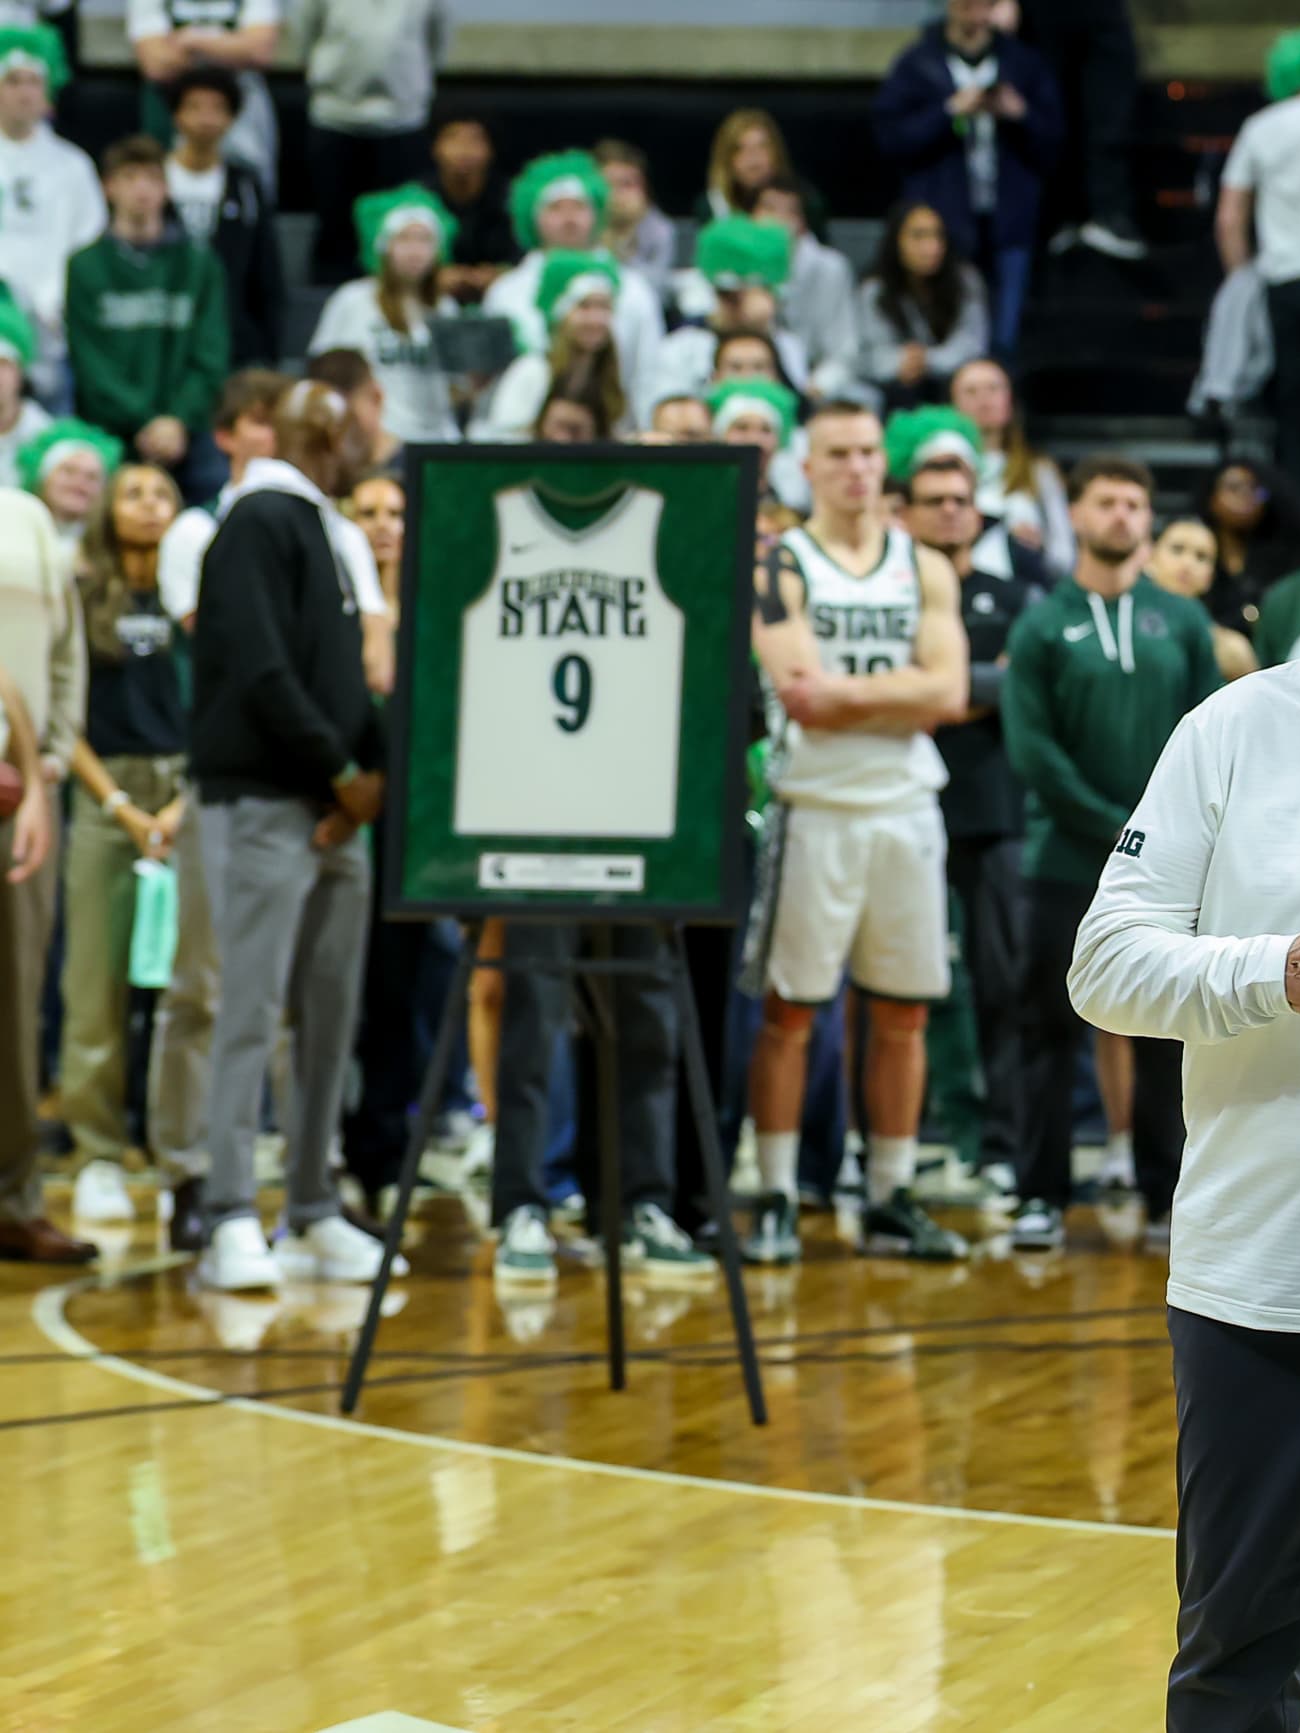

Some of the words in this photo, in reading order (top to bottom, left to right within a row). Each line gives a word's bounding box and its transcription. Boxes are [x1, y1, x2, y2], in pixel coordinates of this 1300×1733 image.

[500, 577, 647, 637] STATE
[814, 604, 911, 641] STATE
[552, 652, 592, 733] 9
